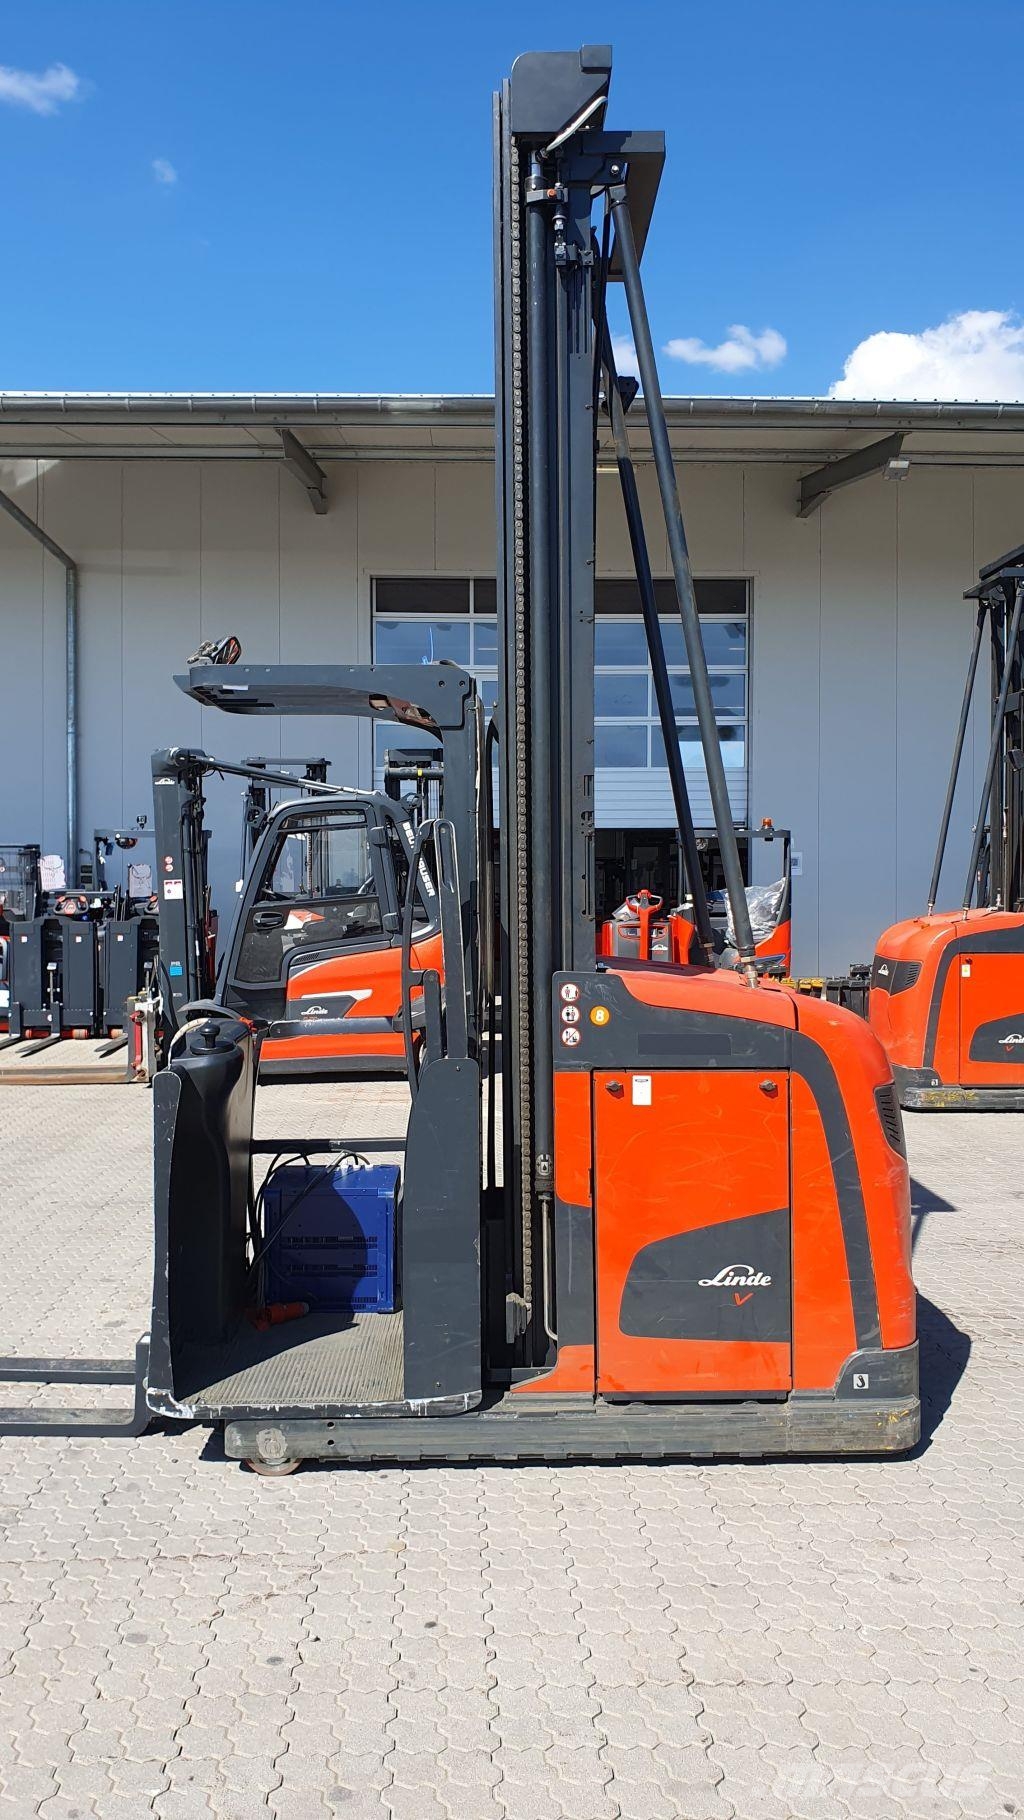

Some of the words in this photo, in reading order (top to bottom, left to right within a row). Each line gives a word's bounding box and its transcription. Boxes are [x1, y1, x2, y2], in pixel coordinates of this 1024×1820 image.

[402, 822, 435, 897] BEUAUSER
[595, 1009, 604, 1022] 8
[998, 1033, 1024, 1044] Lind
[698, 1264, 772, 1286] Linde
